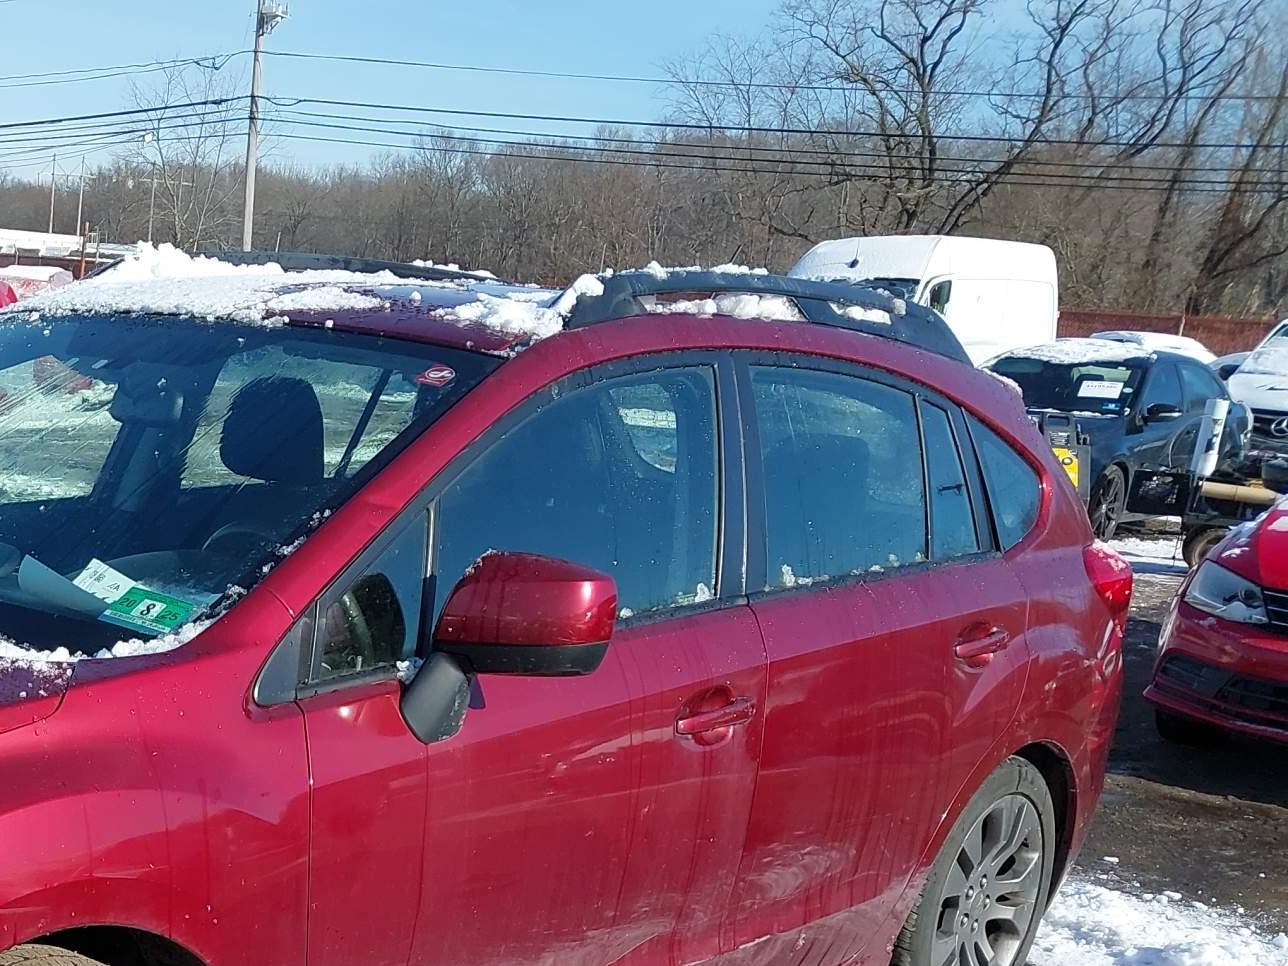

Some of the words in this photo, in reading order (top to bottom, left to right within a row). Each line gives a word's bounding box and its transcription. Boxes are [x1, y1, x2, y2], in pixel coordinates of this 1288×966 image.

[118, 597, 137, 608] 20
[139, 602, 156, 617] 8
[160, 609, 179, 621] 25
